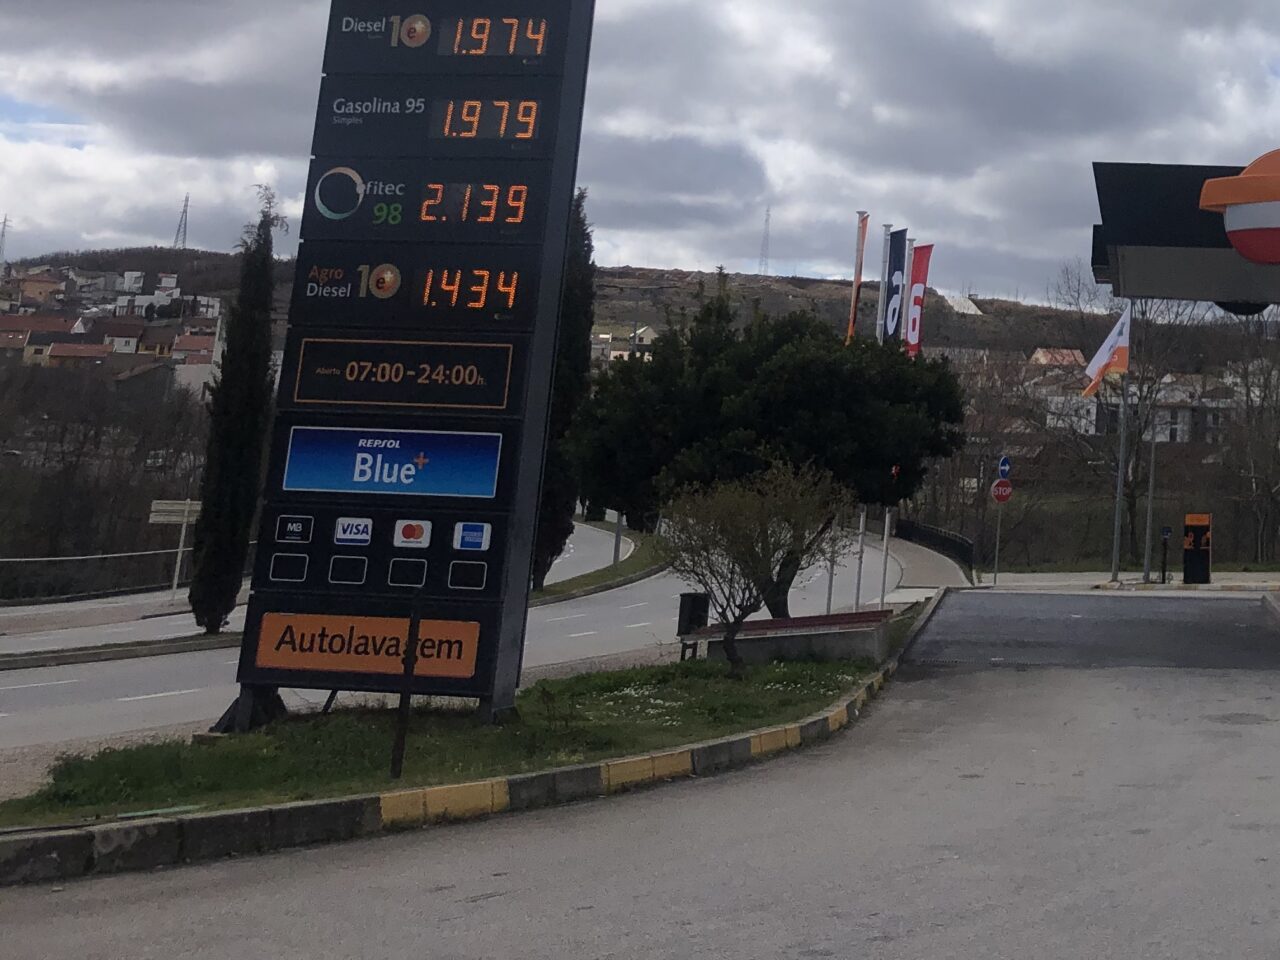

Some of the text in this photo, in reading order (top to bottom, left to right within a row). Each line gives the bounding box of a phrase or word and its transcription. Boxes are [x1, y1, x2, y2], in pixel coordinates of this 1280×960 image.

[341, 16, 386, 32] Diesel
[453, 18, 547, 55] 1.974
[333, 97, 426, 114] Gasolina 95
[443, 100, 538, 138] 1.979
[419, 183, 528, 222] 2.139
[372, 203, 402, 224] 98
[308, 265, 344, 283] Agro
[306, 282, 351, 298] Diesel
[423, 269, 519, 309] 1.434
[358, 438, 400, 448] REPSOL
[994, 487, 1012, 496] STOP
[287, 523, 302, 532] MB
[341, 523, 369, 536] VISA
